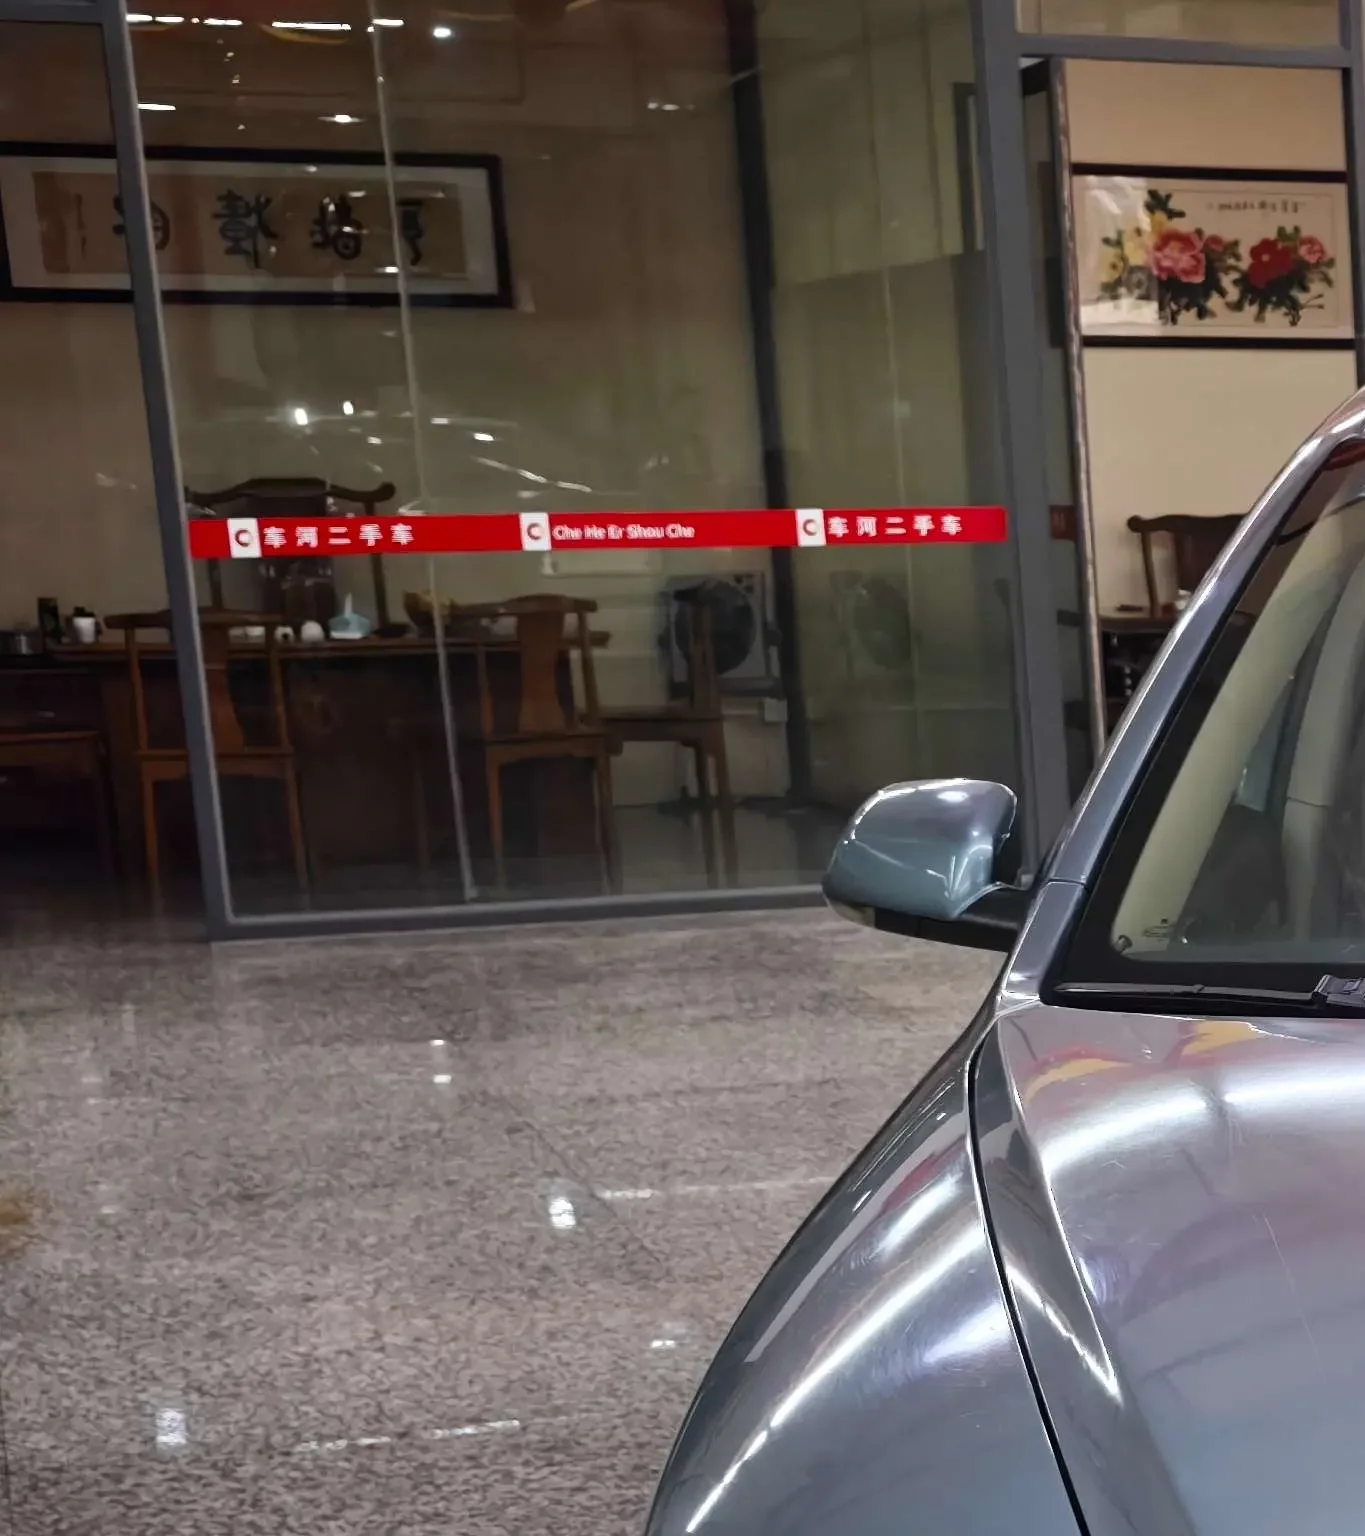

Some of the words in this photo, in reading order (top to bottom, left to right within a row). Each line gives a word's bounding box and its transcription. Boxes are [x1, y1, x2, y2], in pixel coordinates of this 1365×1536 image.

[263, 523, 414, 548] 车河二手车
[625, 523, 666, 539] Shou
[666, 523, 695, 539] Che
[828, 514, 963, 537] 车河二手车
